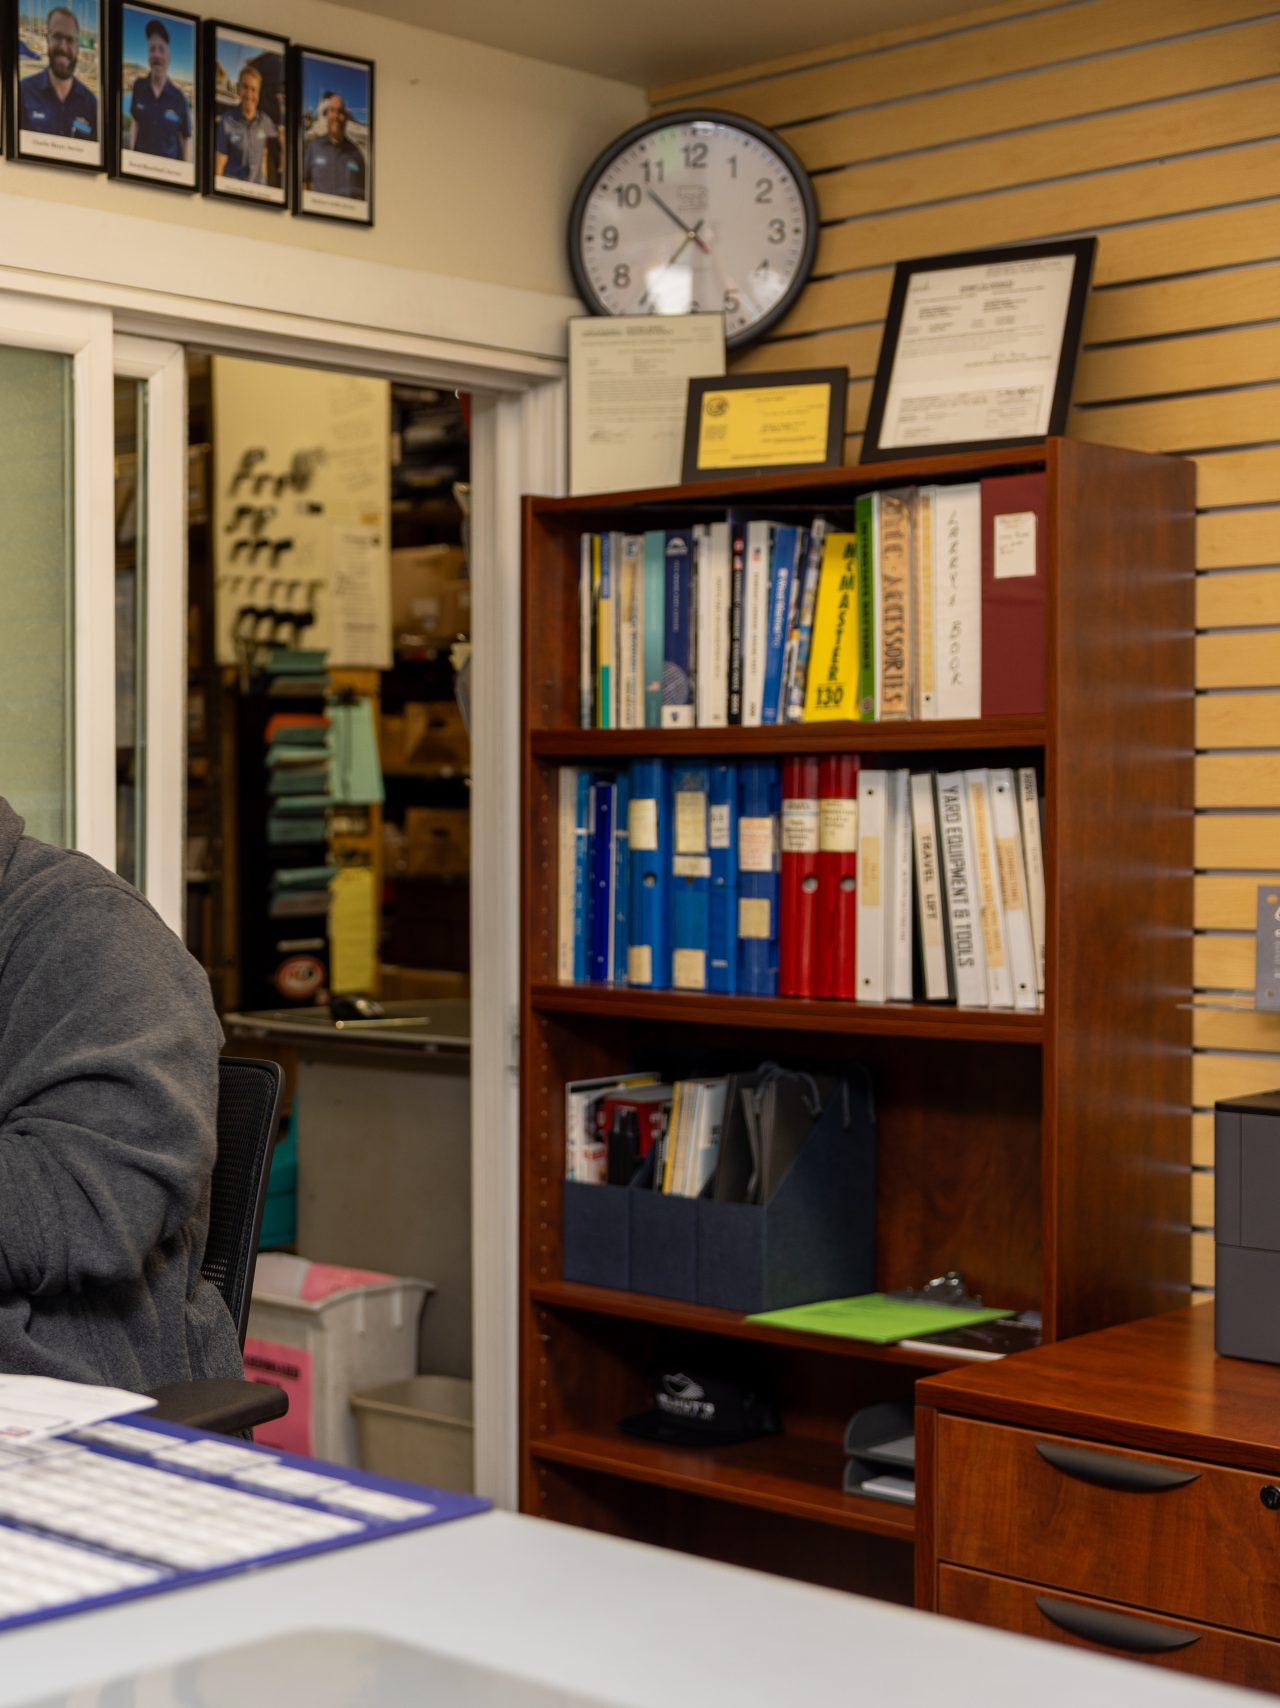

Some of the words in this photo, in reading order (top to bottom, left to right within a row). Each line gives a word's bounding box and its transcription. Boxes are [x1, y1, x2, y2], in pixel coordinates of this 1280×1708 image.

[681, 143, 708, 169] 12
[729, 155, 737, 179] 1
[641, 159, 665, 183] 11
[614, 182, 642, 209] 10
[755, 178, 774, 204] 2
[601, 226, 618, 251] 9
[768, 218, 786, 244] 3
[613, 264, 631, 288] 8
[724, 288, 740, 314] 5
[944, 785, 962, 823] YARD
[922, 835, 935, 882] TRAVEL
[947, 826, 969, 905] EQUIPMENT
[955, 923, 975, 968] TOOLS
